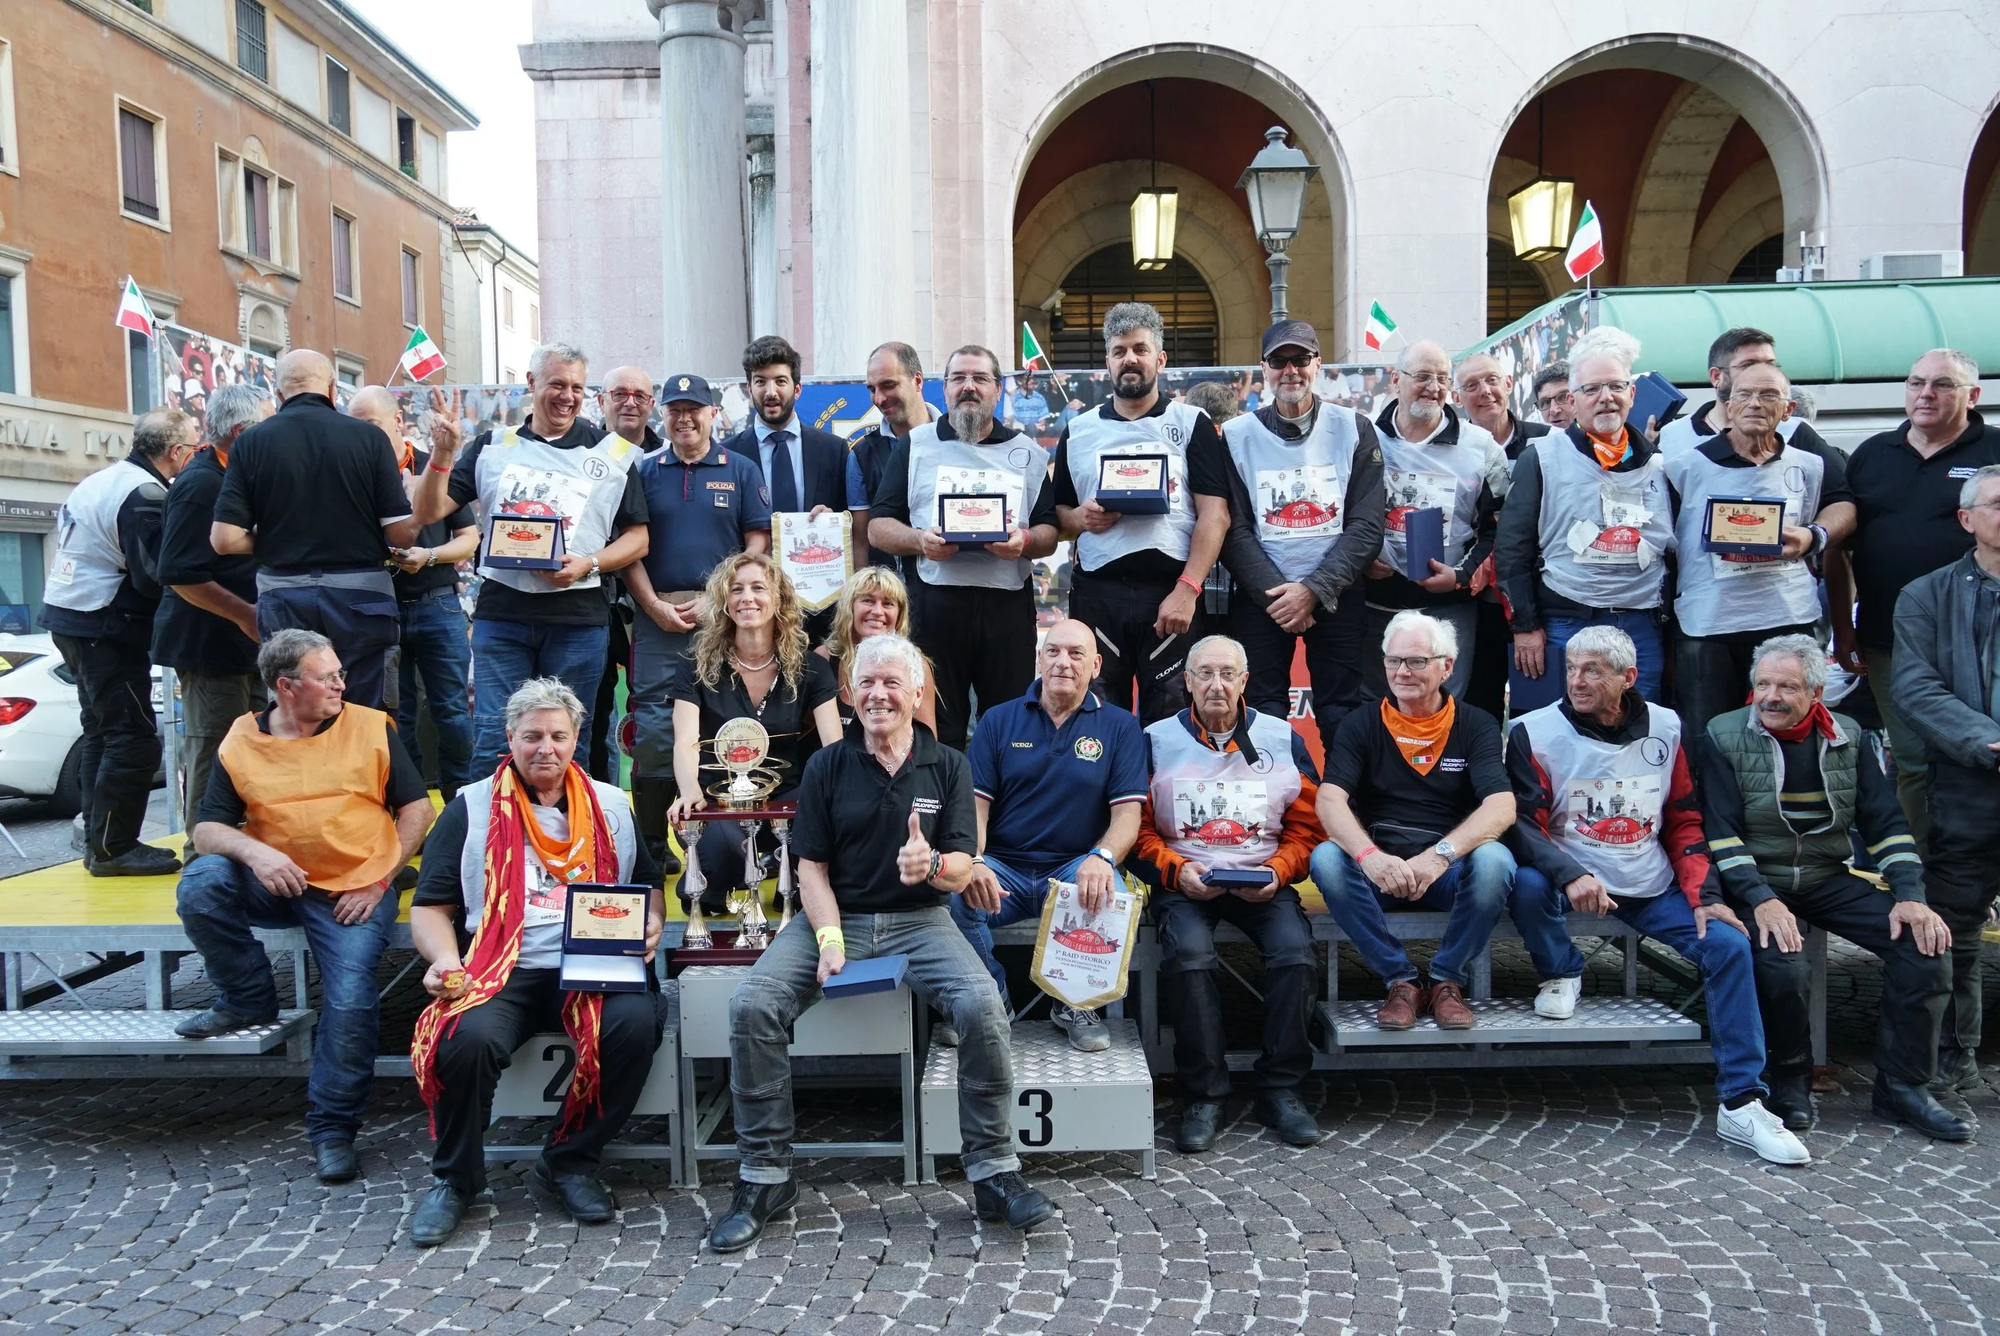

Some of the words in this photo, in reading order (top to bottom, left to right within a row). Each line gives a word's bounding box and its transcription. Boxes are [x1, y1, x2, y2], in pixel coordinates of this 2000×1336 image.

[0, 419, 69, 451] MA
[84, 430, 126, 459] IT
[1166, 427, 1179, 443] 18
[590, 460, 604, 478] 15
[707, 482, 734, 490] POLIZIA
[1650, 480, 1659, 492] 6
[737, 723, 761, 736] STORICO
[1062, 951, 1079, 959] RAID
[1080, 955, 1111, 965] STORICO
[542, 1044, 577, 1103] 2
[1018, 1089, 1054, 1147] 3
